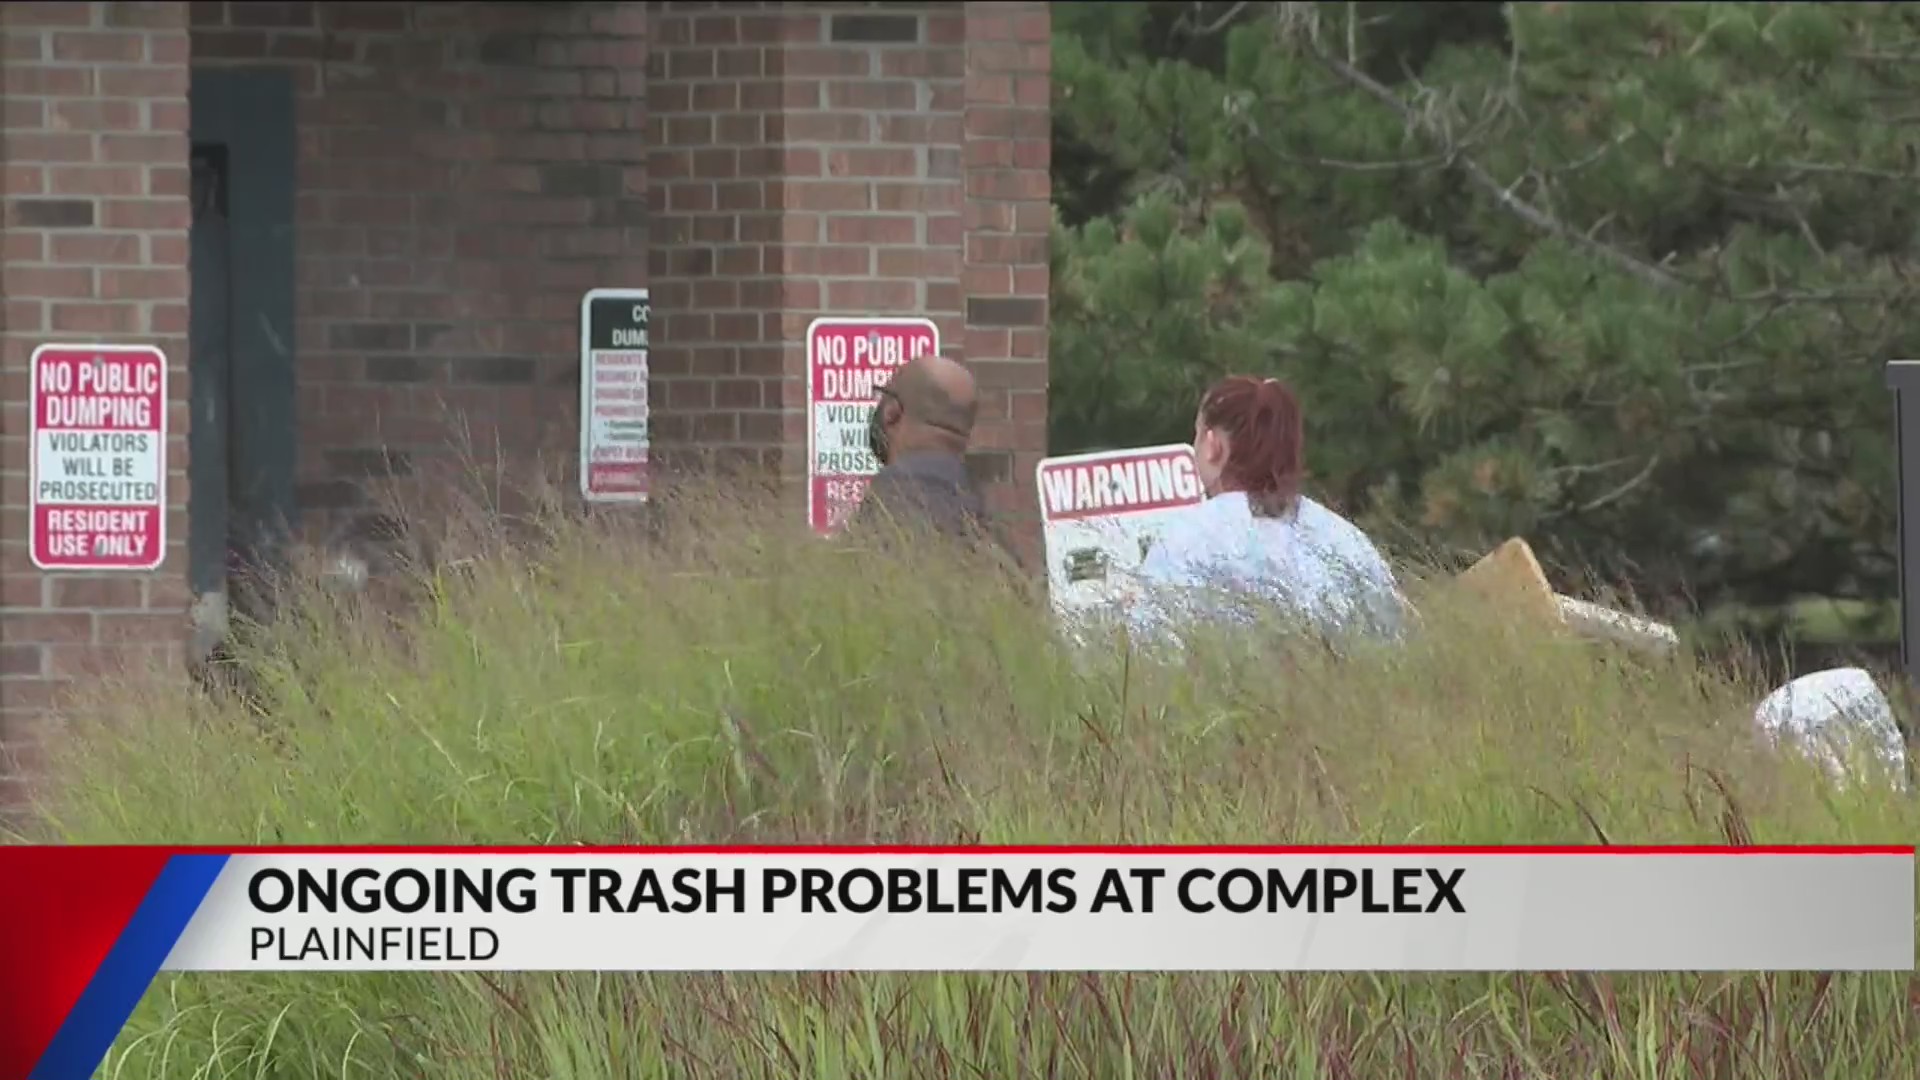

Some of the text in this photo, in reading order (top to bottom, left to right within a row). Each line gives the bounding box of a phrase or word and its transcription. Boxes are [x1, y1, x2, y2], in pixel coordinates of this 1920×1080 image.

[816, 335, 931, 366] NO PUBLIC
[41, 362, 158, 394] NO PUBLIC
[46, 396, 151, 427] DUMPING
[49, 433, 149, 453] VIOLATORS
[62, 457, 134, 477] WILL BE
[39, 481, 157, 501] PROSECUTED
[1043, 455, 1198, 513] WARNING
[48, 510, 149, 532] RESIDENT
[48, 534, 148, 557] USE ONLY
